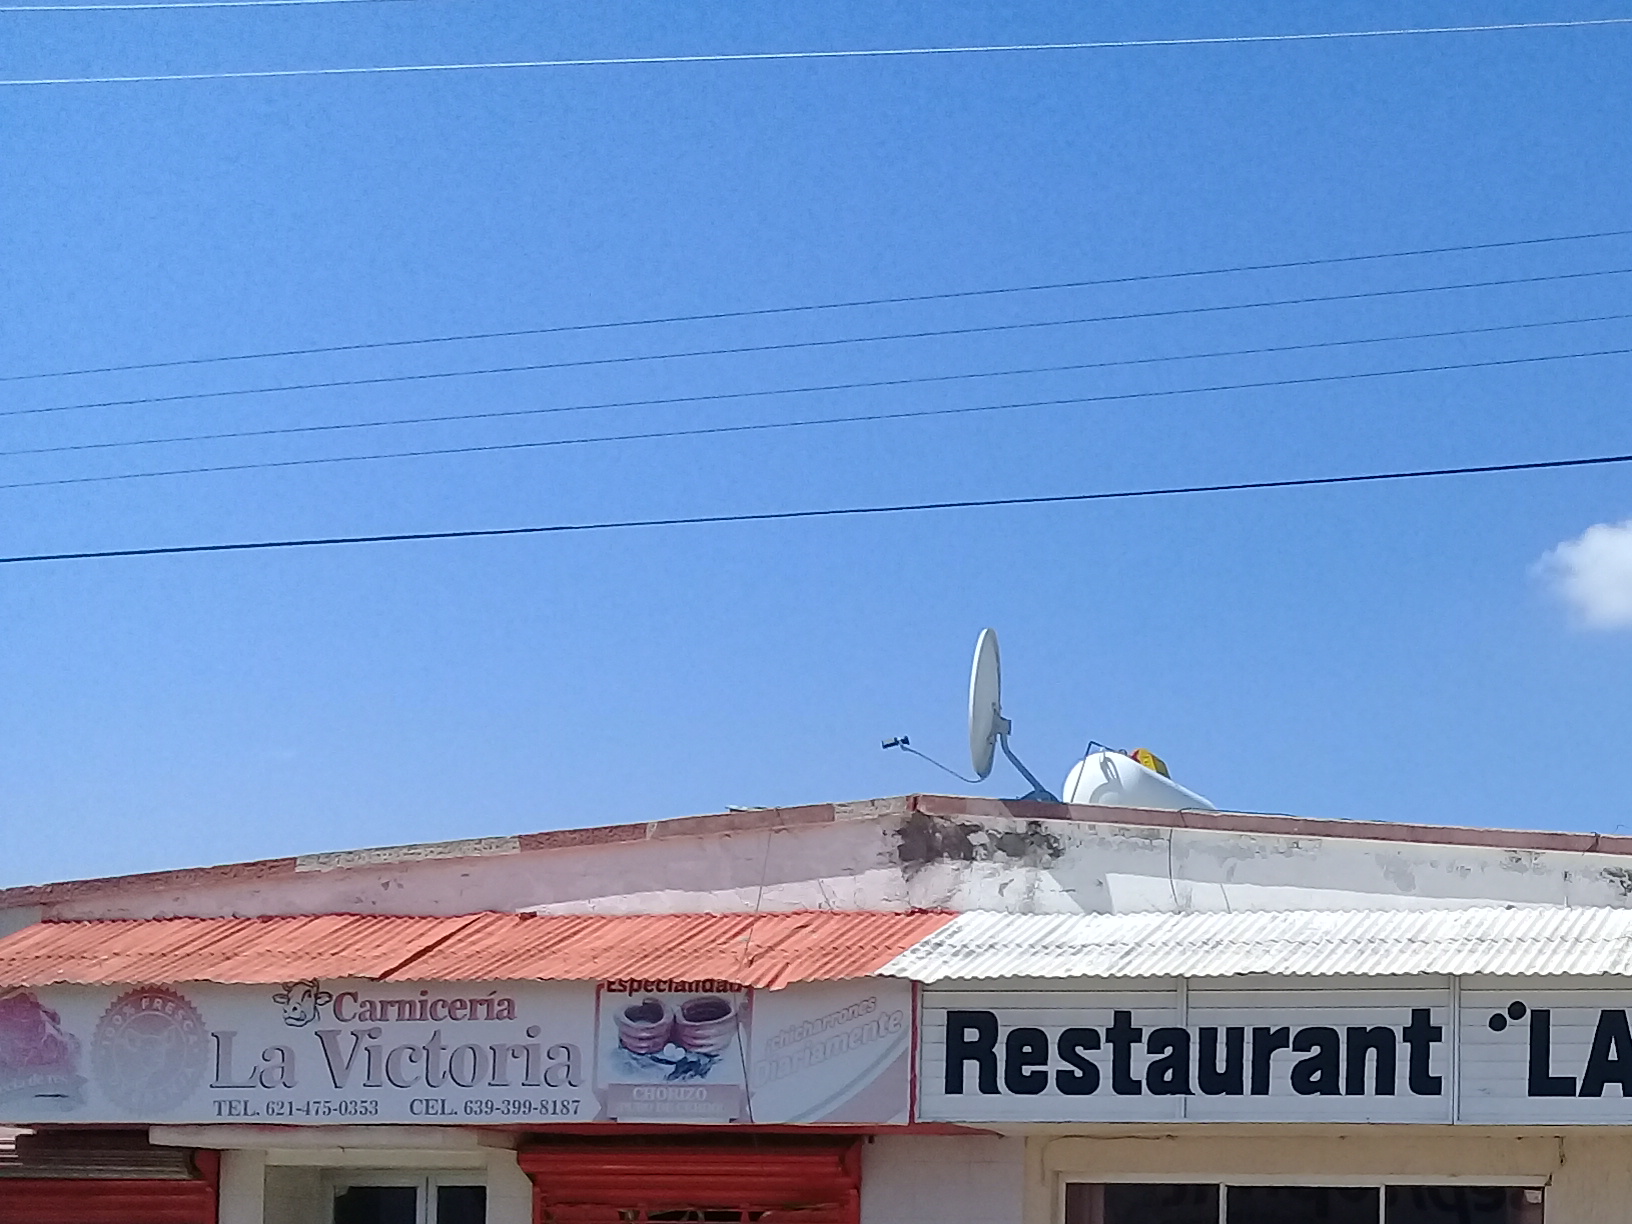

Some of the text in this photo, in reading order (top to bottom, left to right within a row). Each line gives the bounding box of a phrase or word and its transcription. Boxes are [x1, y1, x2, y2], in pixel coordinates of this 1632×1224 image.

[332, 989, 518, 1022] Carnicería
[209, 1030, 299, 1089] La
[314, 1025, 584, 1089] Victoria
[752, 1008, 904, 1089] Diariamente
[944, 1008, 1443, 1096] Restaurant
[213, 1098, 581, 1116] TEL. 621-475-0353 CEL. 639-399-8187
[632, 1087, 707, 1101] CHORIZO
